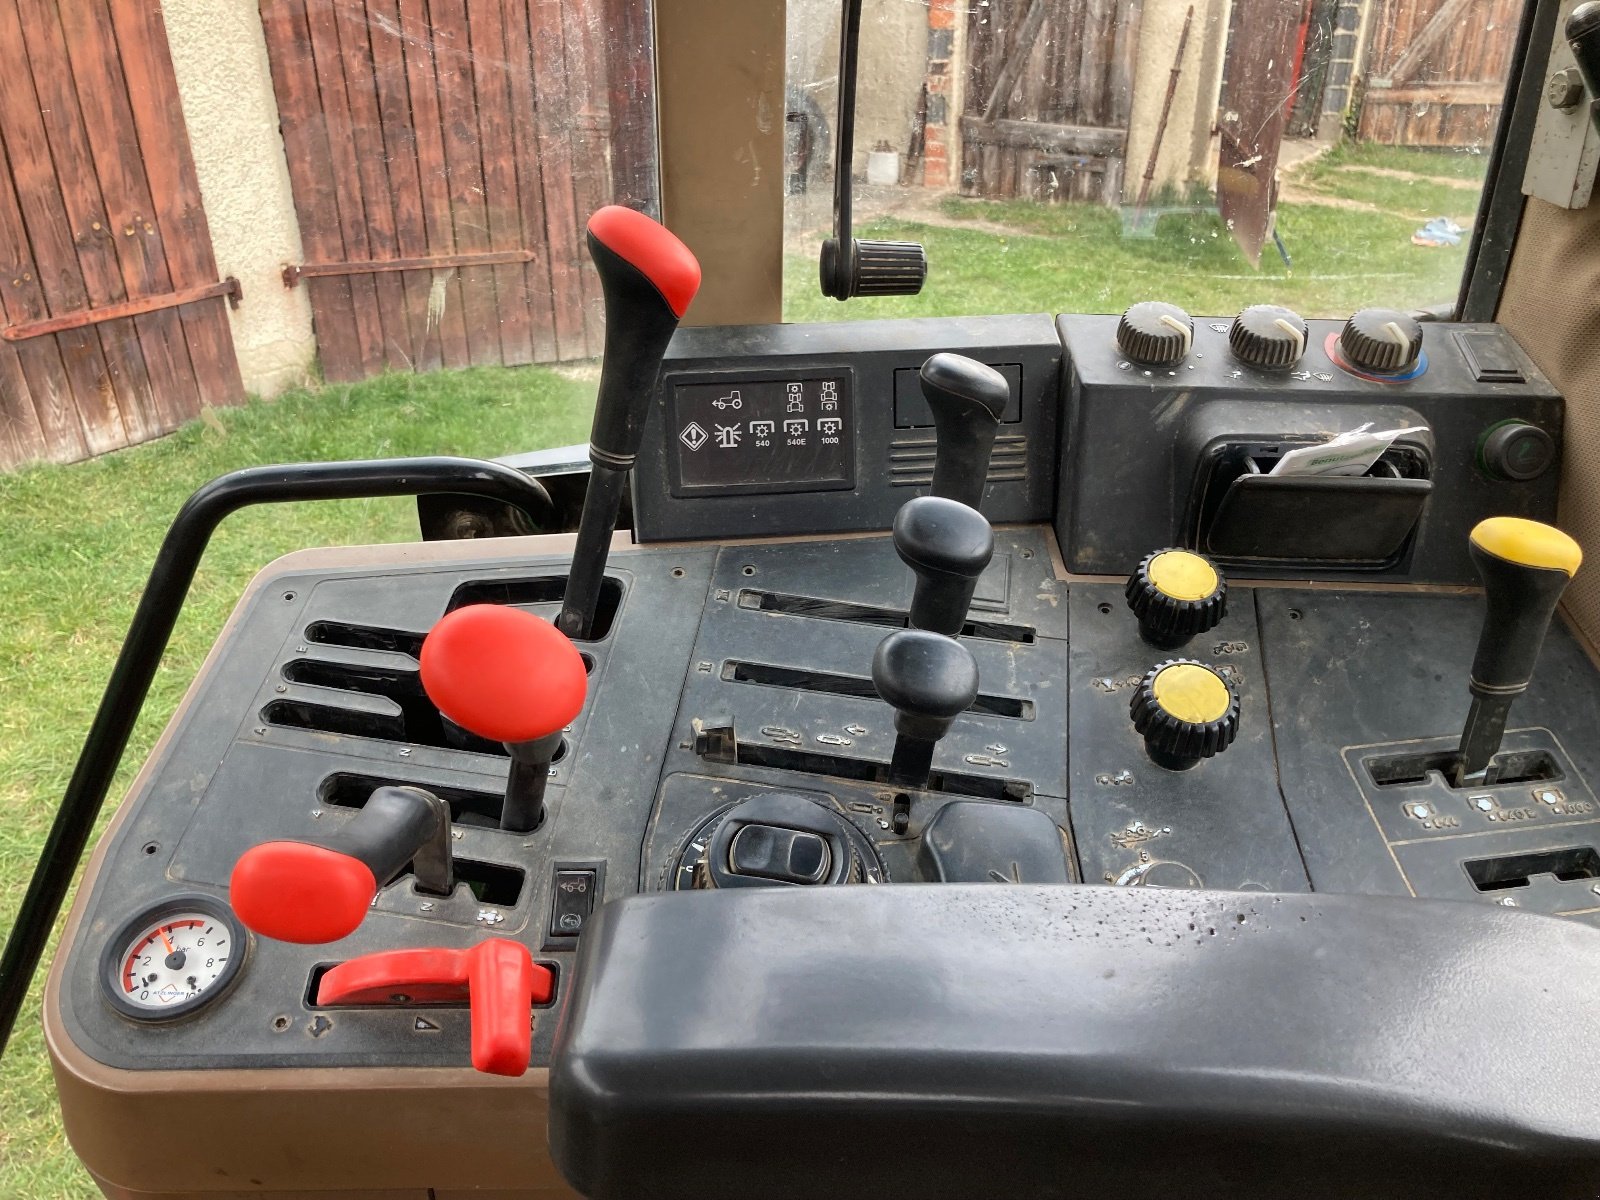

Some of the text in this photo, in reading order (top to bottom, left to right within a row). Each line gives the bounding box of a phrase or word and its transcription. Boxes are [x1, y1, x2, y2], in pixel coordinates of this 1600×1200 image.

[787, 438, 807, 446] 540E
[821, 437, 839, 445] 1000
[167, 935, 175, 945] 4
[197, 938, 205, 947] 6
[176, 944, 192, 953] bar
[142, 956, 152, 966] 2
[206, 958, 214, 968] 8
[140, 990, 149, 1001] 0
